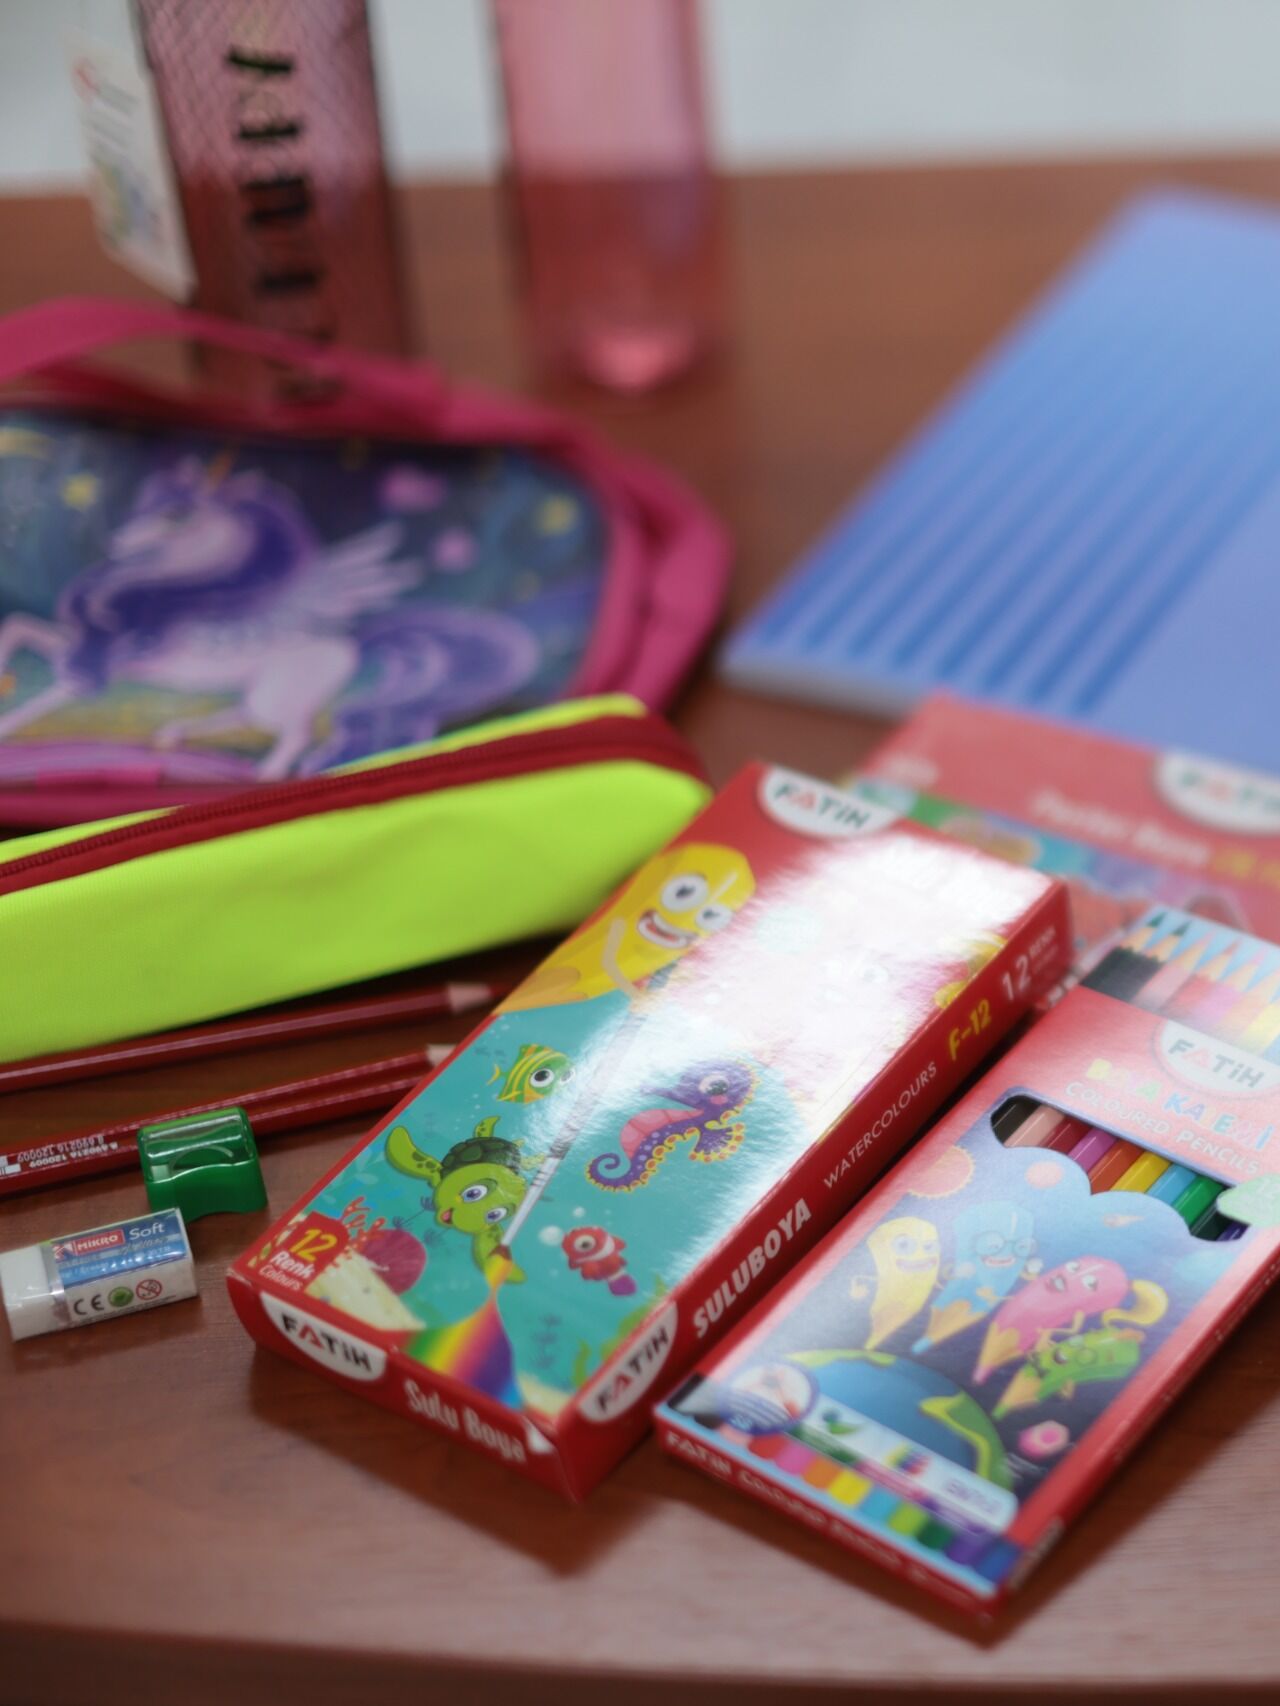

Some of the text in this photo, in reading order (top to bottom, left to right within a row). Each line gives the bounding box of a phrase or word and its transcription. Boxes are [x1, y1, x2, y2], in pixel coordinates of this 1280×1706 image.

[1002, 954, 1032, 1002] 12
[948, 999, 992, 1061] F-12
[823, 1061, 937, 1190] WATERCOLOURS
[129, 1222, 166, 1240] Soft
[291, 1229, 337, 1260] 12
[259, 1264, 303, 1291] Colours
[270, 1252, 314, 1278] Renk
[692, 1198, 812, 1338] SULUBOYA
[404, 1379, 526, 1463] Sulu Boya
